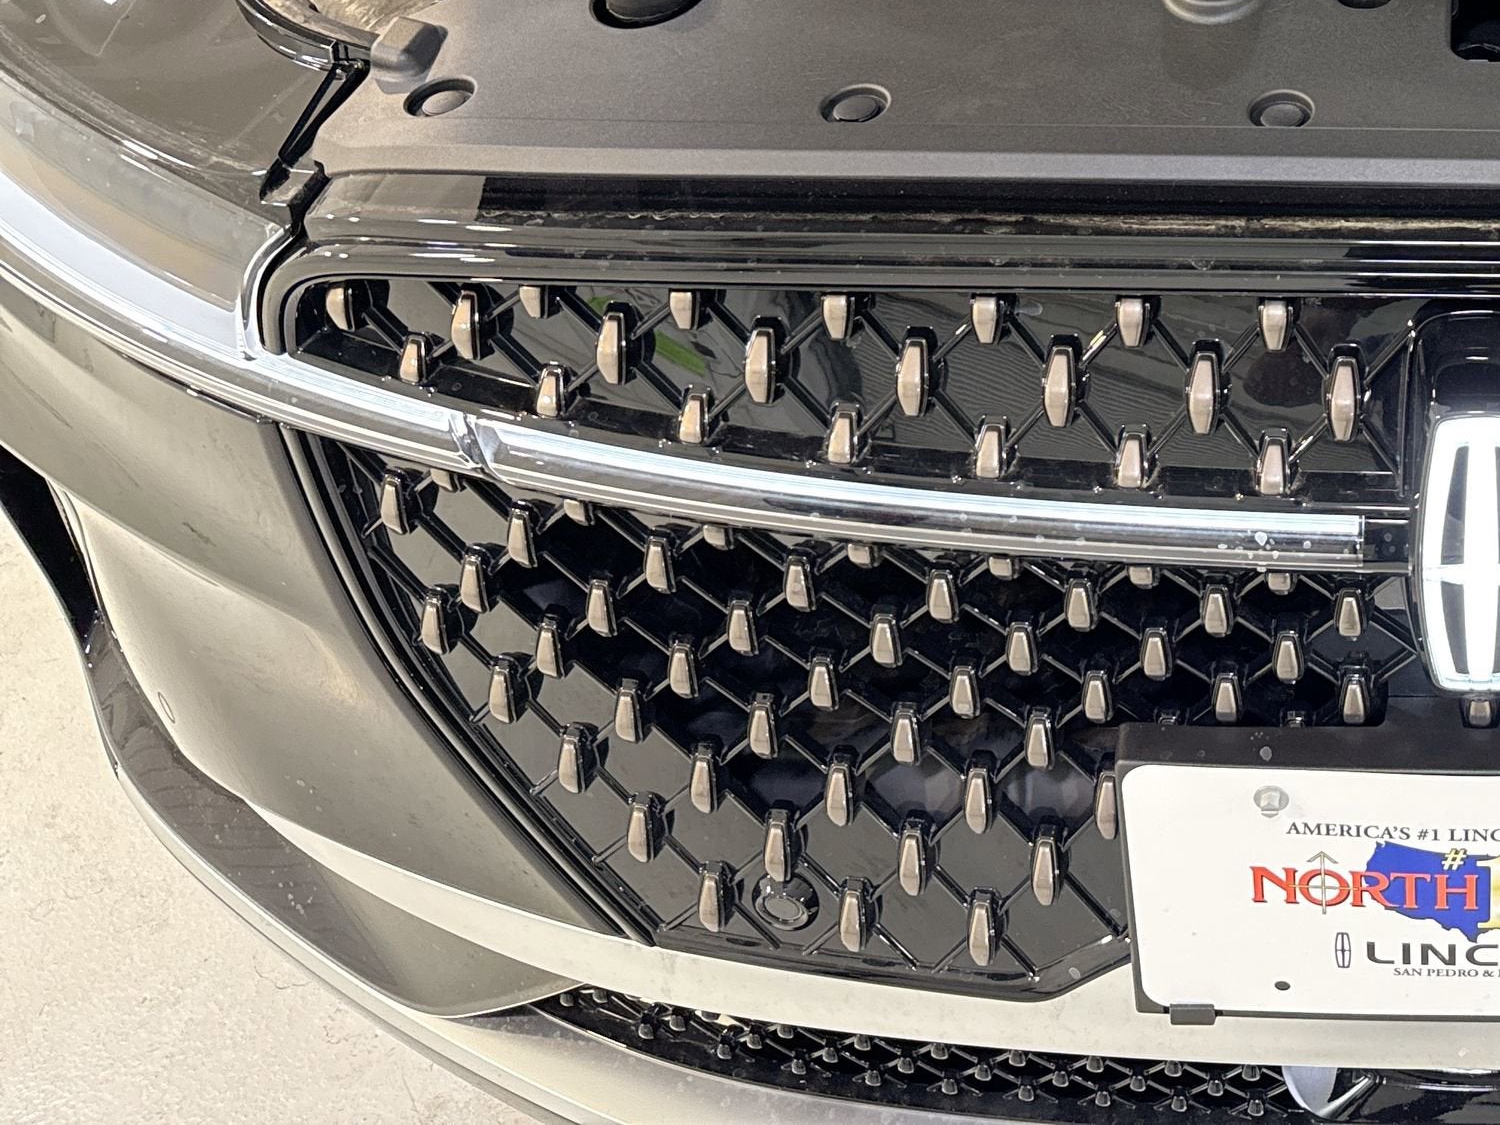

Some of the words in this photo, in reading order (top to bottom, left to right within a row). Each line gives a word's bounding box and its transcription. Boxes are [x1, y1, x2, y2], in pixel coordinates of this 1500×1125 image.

[1286, 821, 1411, 840] AMERICA'S
[1417, 828, 1441, 842] #1
[1249, 864, 1479, 911] NORTH
[1393, 967, 1423, 977] SAN
[1426, 968, 1480, 978] PEDRO
[1482, 968, 1495, 978] &
